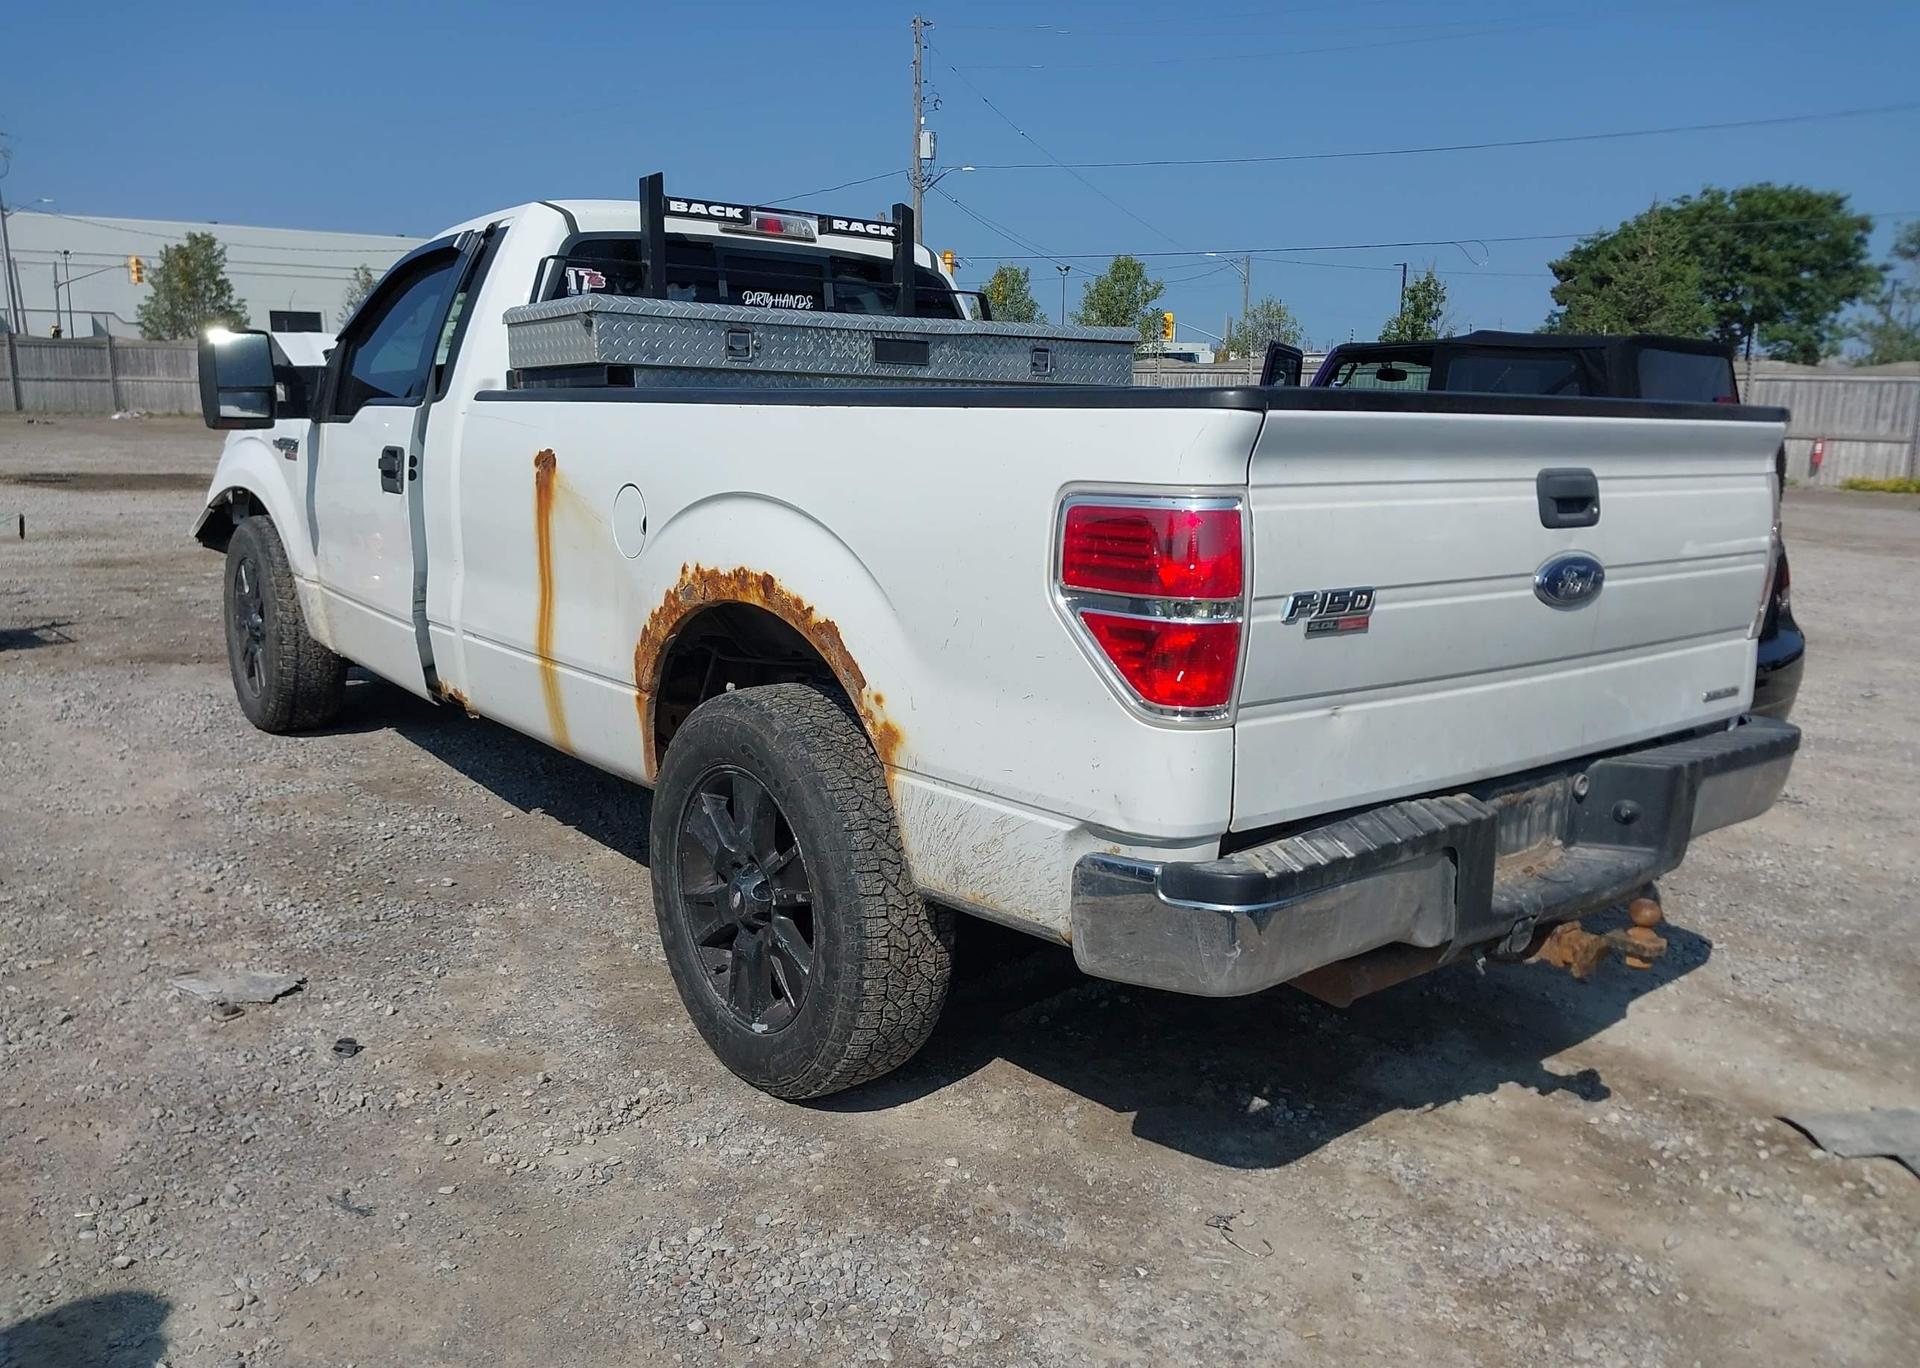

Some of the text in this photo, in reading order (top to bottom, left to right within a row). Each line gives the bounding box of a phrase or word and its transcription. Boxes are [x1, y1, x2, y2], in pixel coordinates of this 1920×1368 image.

[669, 200, 896, 237] BACK RACK
[1280, 586, 1376, 624] F-150
